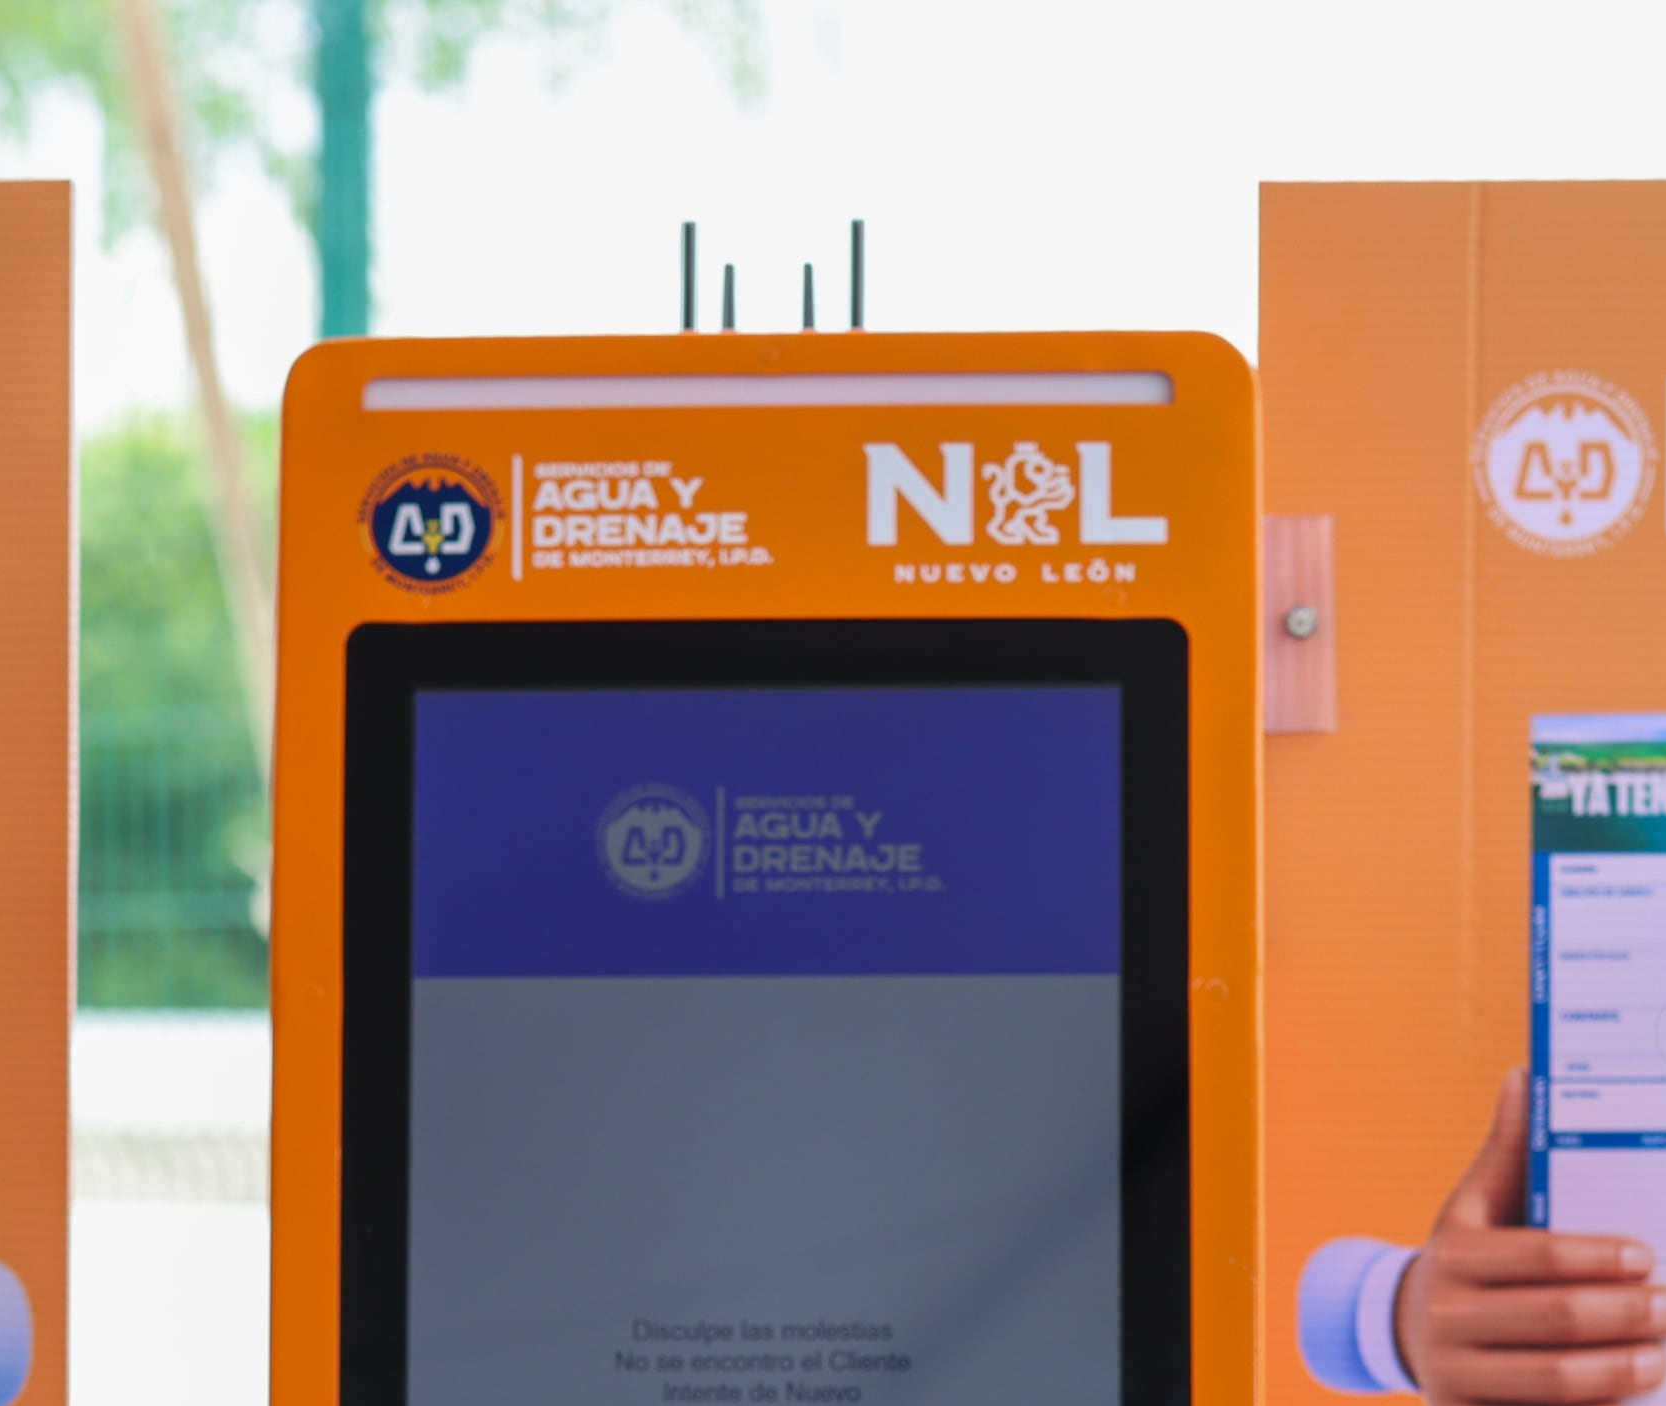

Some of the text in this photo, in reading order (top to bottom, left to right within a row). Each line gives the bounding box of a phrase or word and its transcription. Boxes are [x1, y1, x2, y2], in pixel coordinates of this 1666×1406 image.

[534, 461, 672, 479] SERVICIOS DE
[533, 477, 704, 511] AGUA Y
[533, 513, 748, 547] DRENAJE
[533, 550, 565, 568] DE
[894, 558, 1136, 583] NUEVO LEÓN
[1569, 771, 1610, 816] YA
[734, 812, 882, 839] AGUA Y
[734, 844, 923, 873] DRENAJE
[632, 1319, 893, 1346] Disculpe las molestias
[615, 1351, 649, 1372] No
[656, 1355, 684, 1372] se
[801, 1351, 822, 1372] el
[828, 1350, 911, 1372] Cliente
[663, 1382, 862, 1403] Intente de Nuevo
